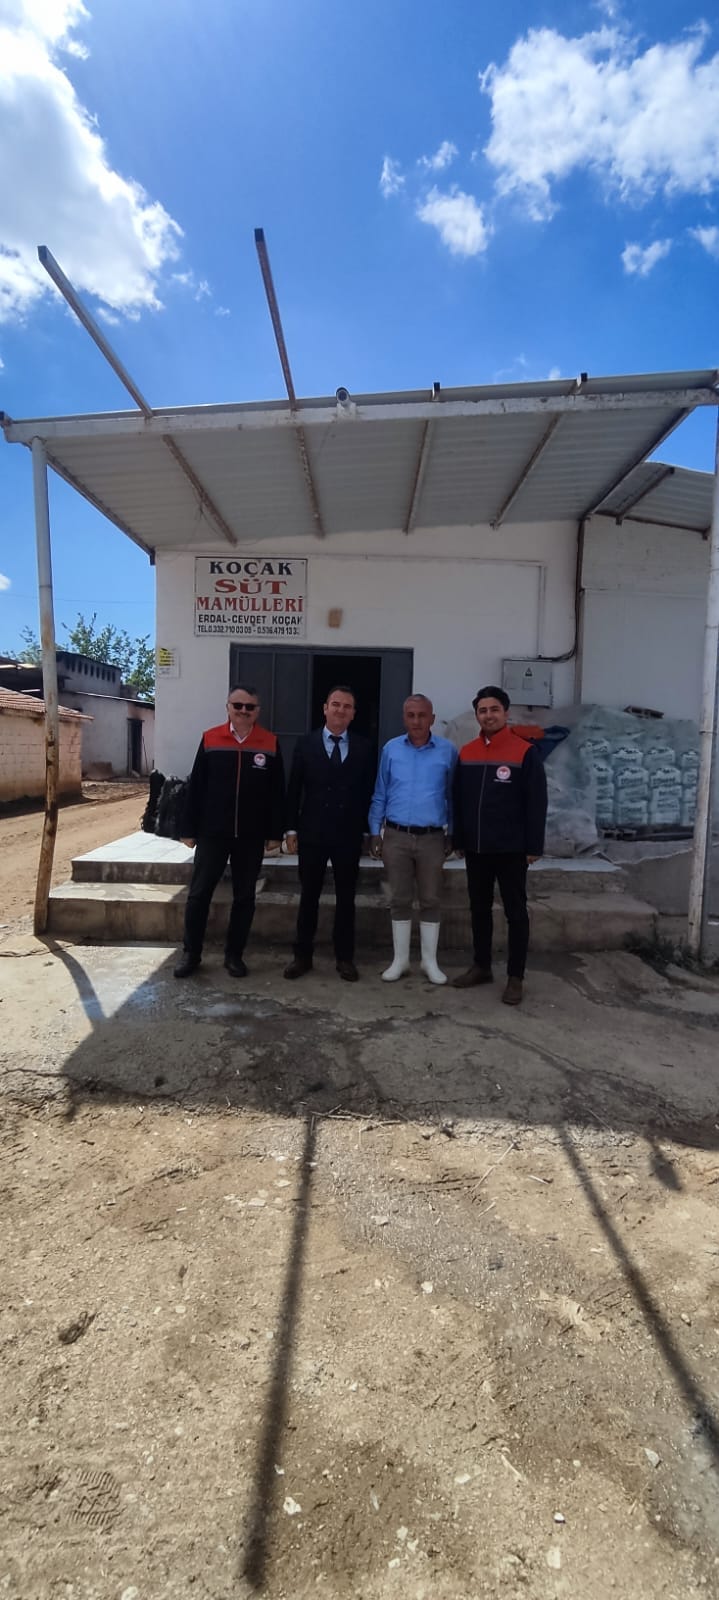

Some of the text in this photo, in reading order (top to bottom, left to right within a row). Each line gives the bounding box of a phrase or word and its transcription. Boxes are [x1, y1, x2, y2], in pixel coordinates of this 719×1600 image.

[209, 561, 293, 577] KOÇAK
[214, 578, 288, 595] SÜT
[196, 595, 304, 612] MAMÜLLERİ
[272, 615, 303, 626] KOÇAK
